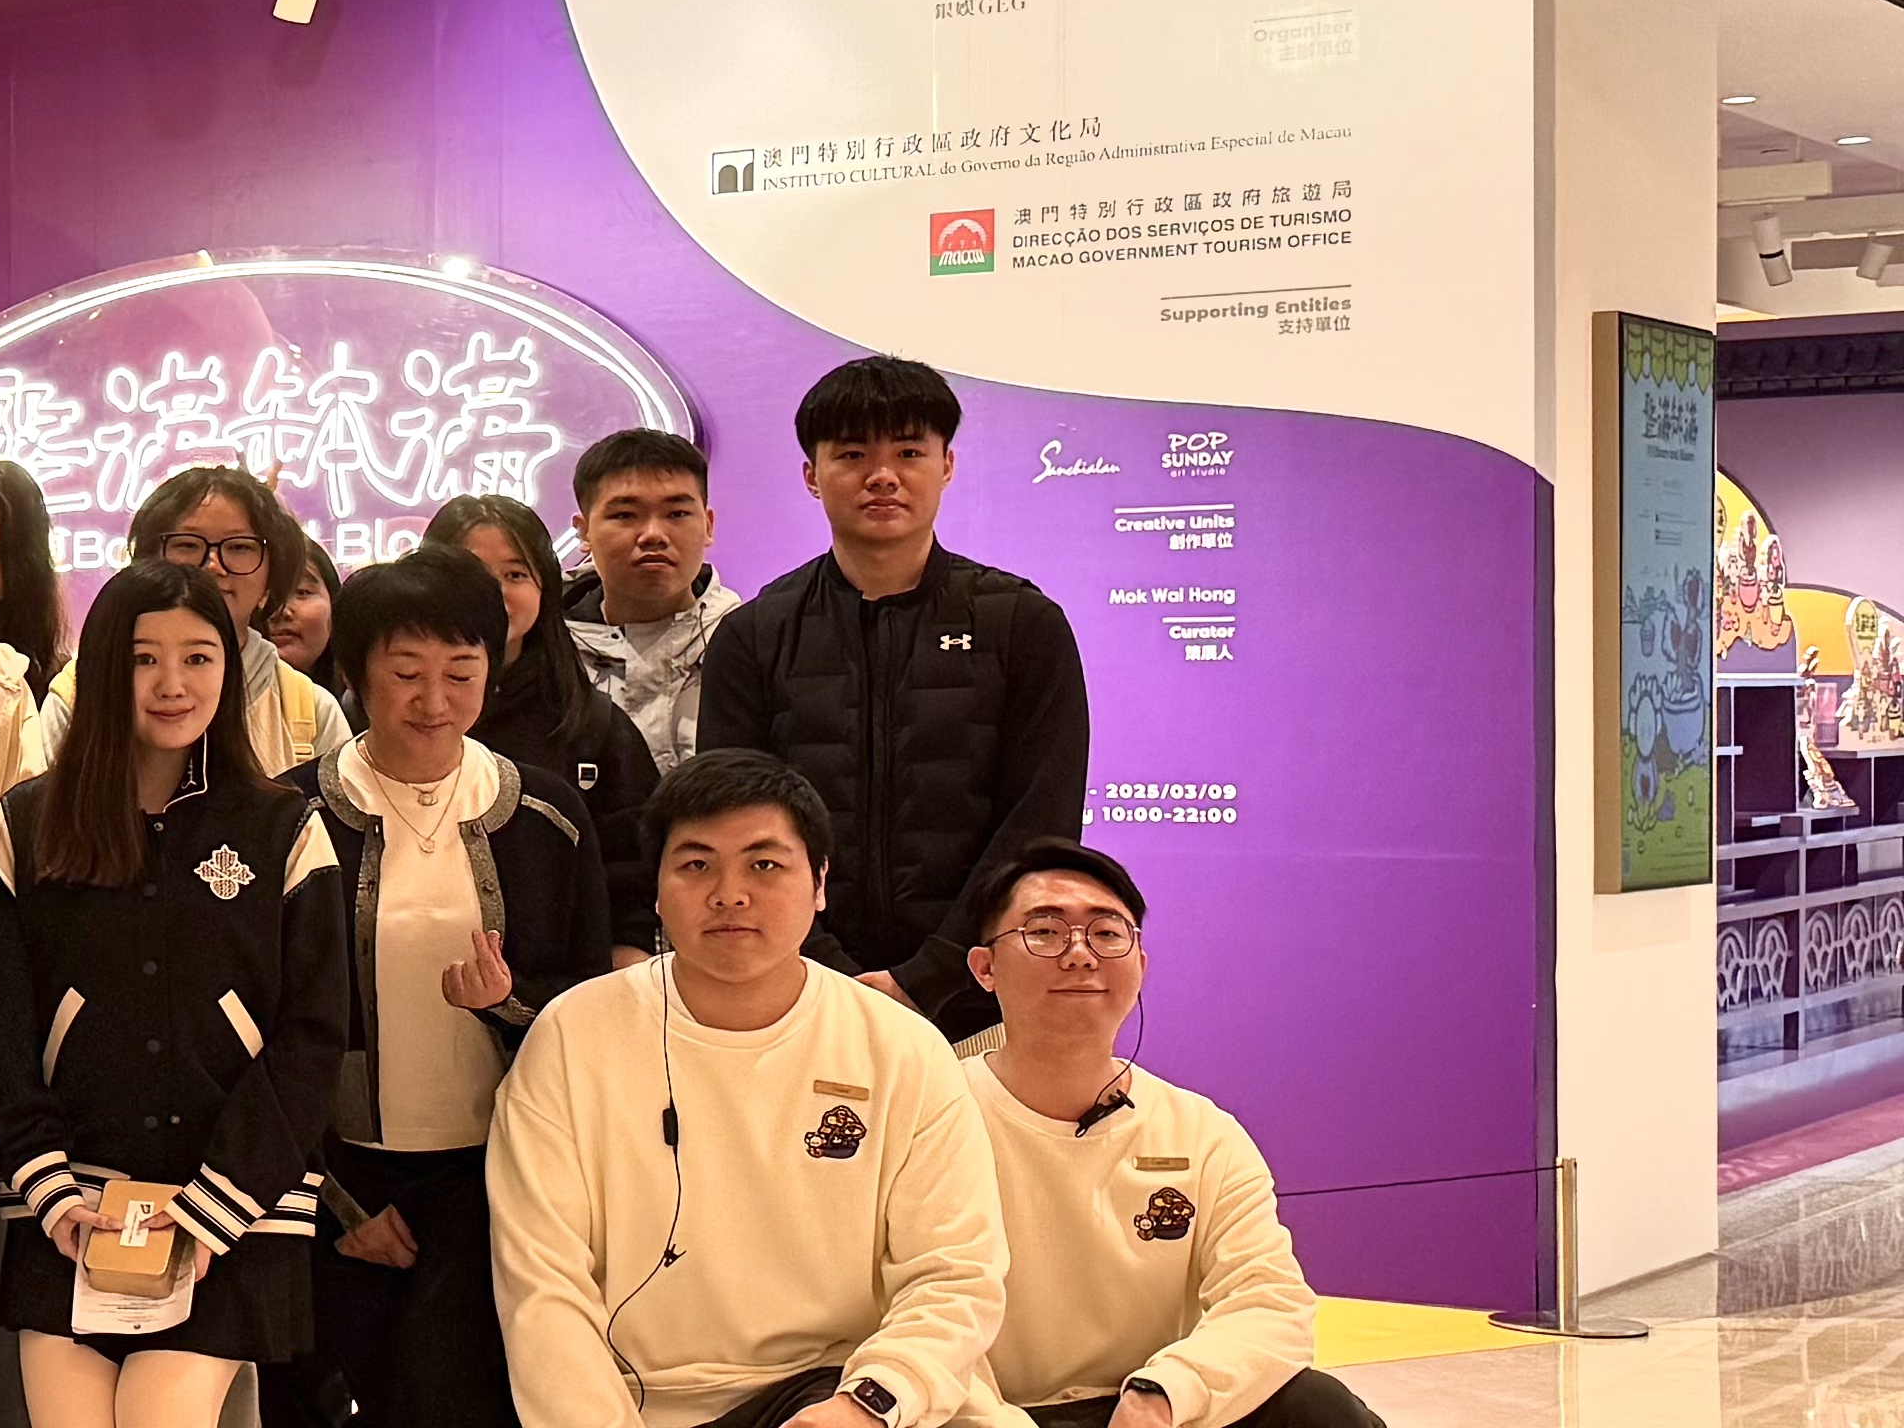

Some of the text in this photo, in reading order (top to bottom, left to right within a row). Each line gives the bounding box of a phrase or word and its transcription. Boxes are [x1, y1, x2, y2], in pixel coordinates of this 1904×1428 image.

[762, 116, 1101, 169] 澳門特別行政區政府文化局
[762, 126, 1352, 191] INSTITUTO CULTURAL do Governo da Região Administrativa Especial de Macau
[1013, 180, 1352, 225] 澳門特別行政區政府旅遊局
[1012, 208, 1352, 249] DIRECÇÃO DOS SERVIÇOS DE TURISMO
[1012, 229, 1352, 270] MACAO GOVERNMENT TOURISM OFFICE
[1160, 296, 1352, 323] Supporting Entities
[1277, 315, 1352, 336] 支持單位
[1167, 431, 1228, 452] POP
[1161, 450, 1235, 469] SUNDAY
[1169, 467, 1187, 478] art
[1113, 513, 1235, 533] Creative Units
[1108, 586, 1236, 605] Mok Wai Hong
[1169, 625, 1236, 640] Curator
[1105, 783, 1237, 801] 2025/03/09
[1102, 806, 1237, 824] 10:00-22:00
